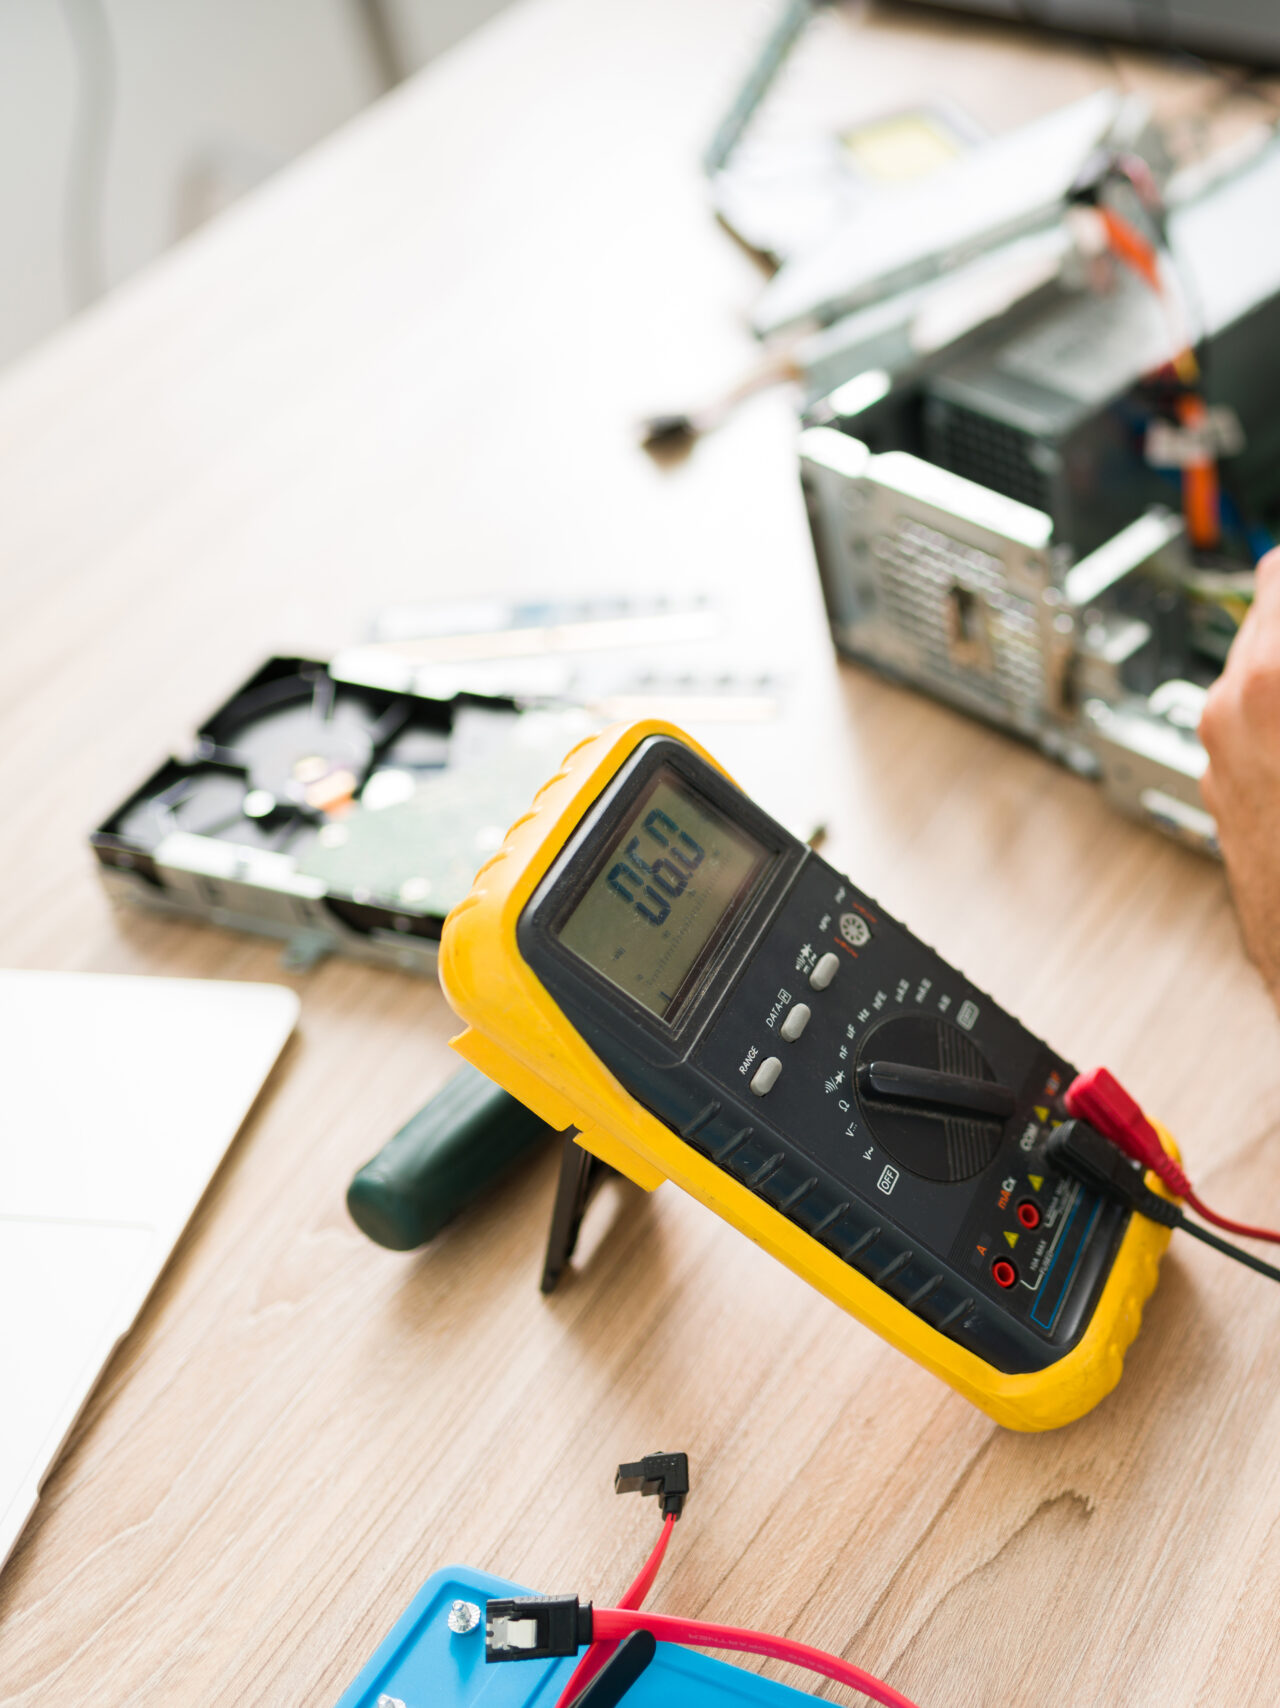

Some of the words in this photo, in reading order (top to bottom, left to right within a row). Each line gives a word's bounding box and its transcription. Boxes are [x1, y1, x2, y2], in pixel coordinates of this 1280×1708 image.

[739, 1045, 759, 1076] RANGE
[839, 1045, 849, 1060] nF
[838, 1099, 850, 1113] Ω
[1019, 1122, 1040, 1152] COM
[881, 1168, 895, 1191] OFF
[976, 1244, 988, 1257] A
